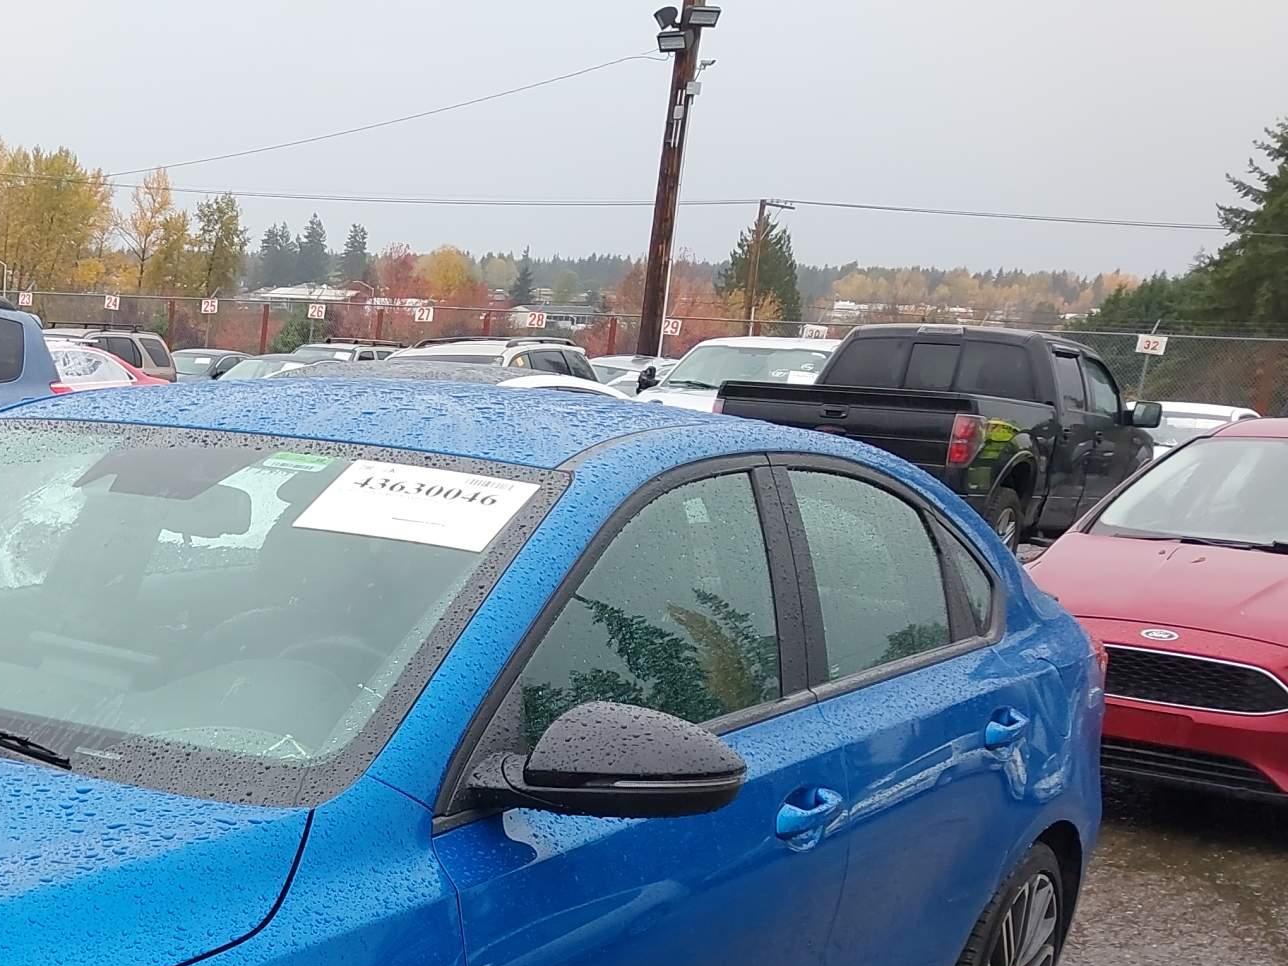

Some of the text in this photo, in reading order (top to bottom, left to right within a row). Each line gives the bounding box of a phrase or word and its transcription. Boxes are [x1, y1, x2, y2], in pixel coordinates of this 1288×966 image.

[20, 293, 31, 305] 23
[106, 297, 118, 310] 24
[203, 300, 217, 313] 25
[309, 305, 324, 318] 26
[417, 308, 432, 321] 27
[528, 313, 545, 326] 28
[663, 321, 679, 334] 29
[1143, 340, 1159, 351] 32
[353, 476, 497, 506] 43630046
